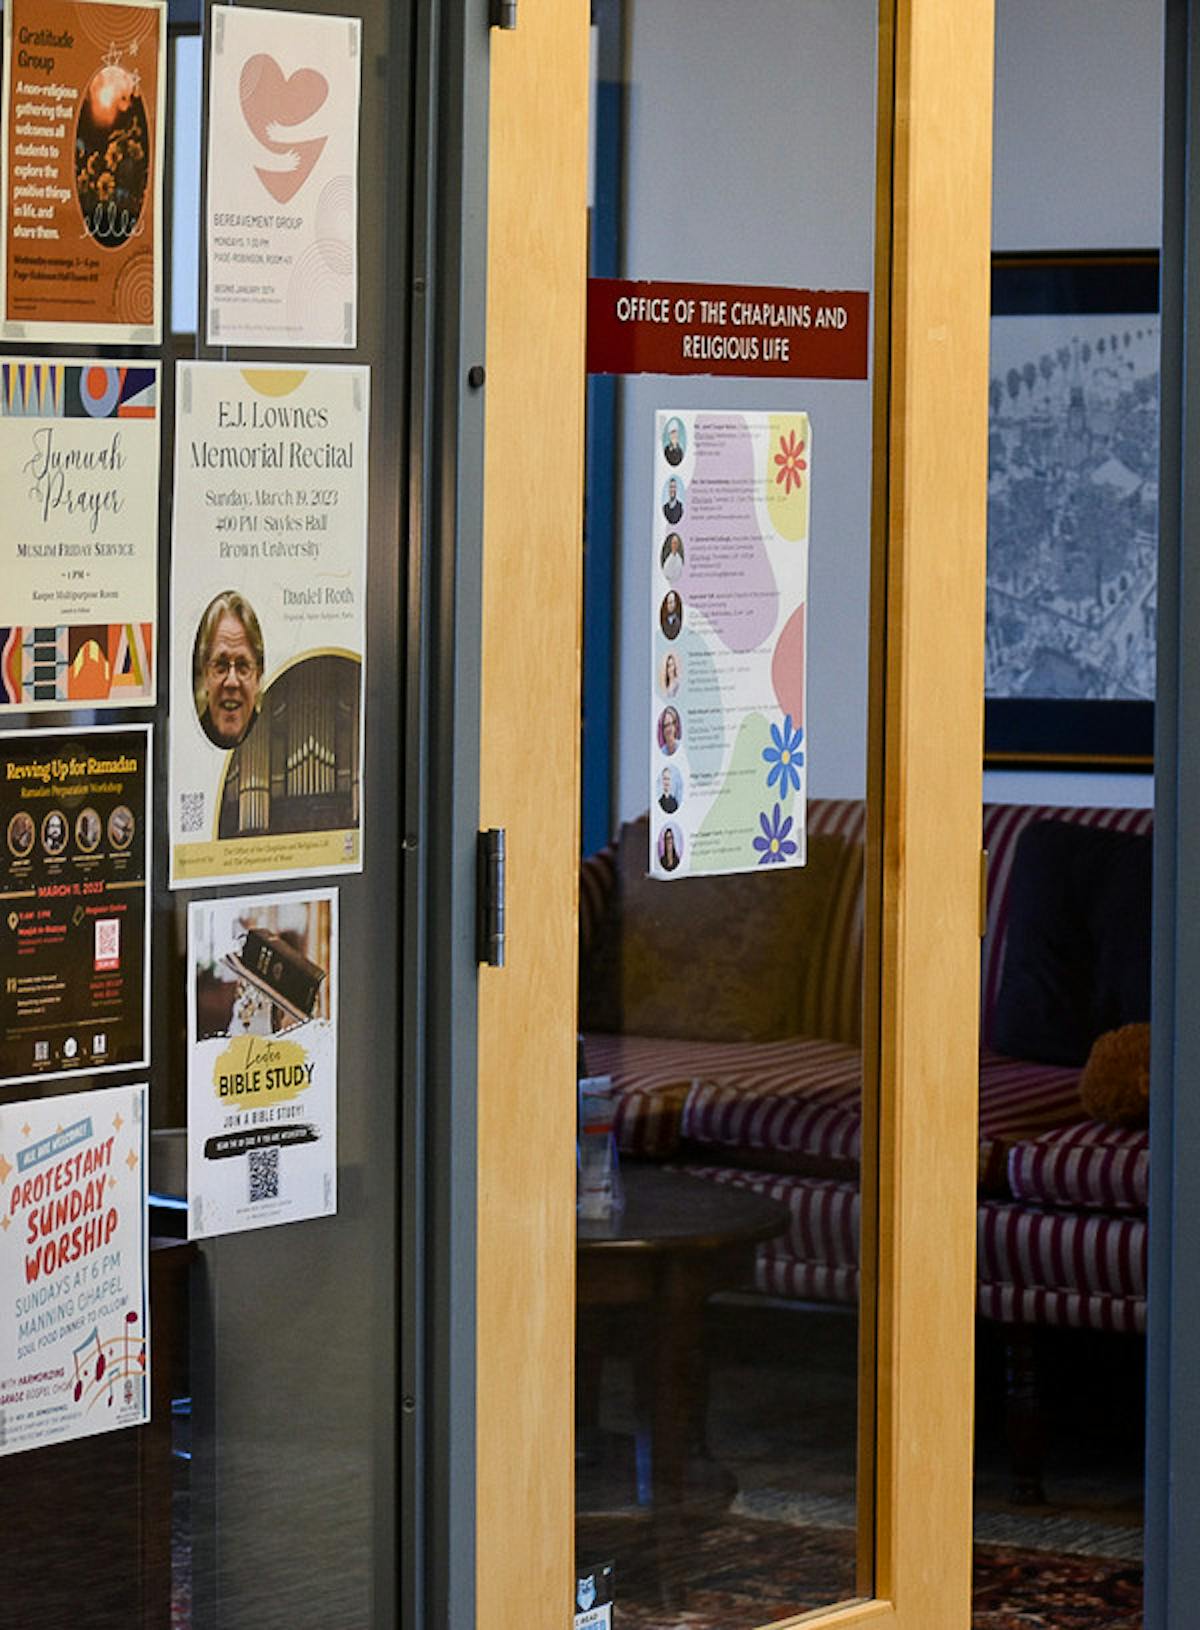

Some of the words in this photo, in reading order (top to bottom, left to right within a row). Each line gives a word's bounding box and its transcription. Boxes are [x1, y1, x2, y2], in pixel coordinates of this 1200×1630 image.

[19, 27, 74, 49] Gratitude
[18, 50, 55, 75] Group
[16, 102, 55, 121] gathering
[213, 213, 274, 229] BEREAVEMENT
[276, 215, 304, 230] GROUP
[616, 296, 670, 323] OFFICE
[674, 298, 697, 323] OF
[699, 300, 728, 325] THE
[731, 302, 812, 329] CHAPLAINS
[815, 306, 849, 330] AND
[681, 334, 760, 361] RELIGIOUS
[763, 336, 792, 362] LIFE
[252, 401, 329, 429] Lownes
[23, 427, 126, 481] Jumuah
[191, 441, 283, 469] Memorial
[288, 441, 353, 469] Recital
[29, 469, 124, 534] Prayer
[205, 489, 253, 510] Sunday,
[254, 489, 295, 507] March
[311, 489, 339, 507] 2023
[263, 514, 304, 537] Sayles
[305, 513, 329, 531] Hall
[17, 543, 57, 558] MUSLIM
[58, 543, 92, 558] FRIDAY
[94, 542, 135, 558] SERVICE
[219, 541, 260, 559] Brown
[261, 539, 319, 561] University
[283, 587, 323, 606] Daniel
[325, 587, 354, 606] Roth
[7, 761, 51, 783] Revving
[52, 759, 69, 781] Up
[70, 758, 87, 776] for
[88, 755, 138, 775] Ramadan
[38, 884, 71, 897] MARCH
[219, 1071, 261, 1098] BIBLE
[266, 1062, 315, 1090] STUDY
[224, 1113, 242, 1129] JOIN
[251, 1108, 274, 1124] BIBLE
[10, 1136, 114, 1216] PROTESTANT
[27, 1173, 106, 1245] SUNDAY
[25, 1208, 118, 1284] WORSHIP
[16, 1275, 71, 1318] SUNDAYS
[73, 1266, 89, 1290] AT
[91, 1262, 99, 1279] 6
[101, 1252, 121, 1276] PM
[18, 1299, 75, 1341] MANNING
[78, 1276, 122, 1313] CHAPEL
[59, 1316, 85, 1341] DINNER
